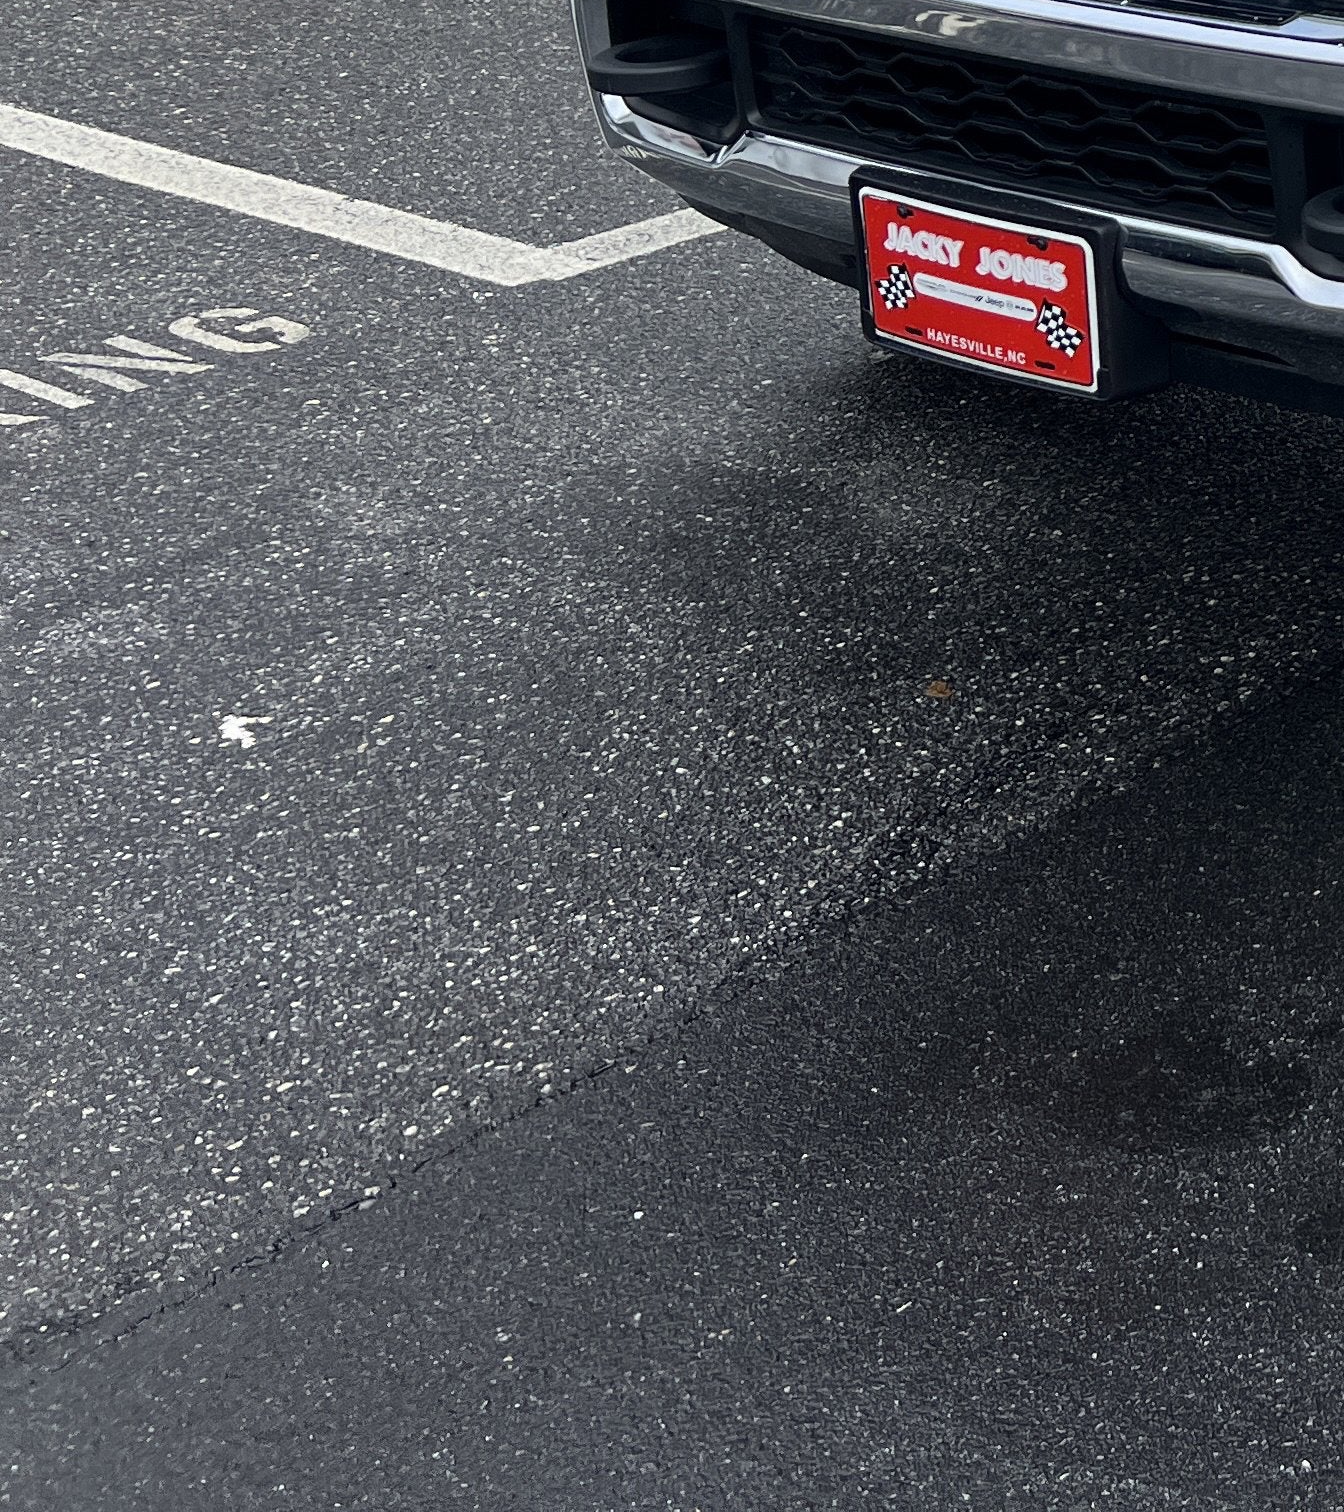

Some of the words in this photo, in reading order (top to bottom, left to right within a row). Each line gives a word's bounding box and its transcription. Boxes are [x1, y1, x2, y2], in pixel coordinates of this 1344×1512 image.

[883, 222, 965, 268] JACKY
[975, 245, 1068, 293] JONES
[0, 307, 311, 425] ING
